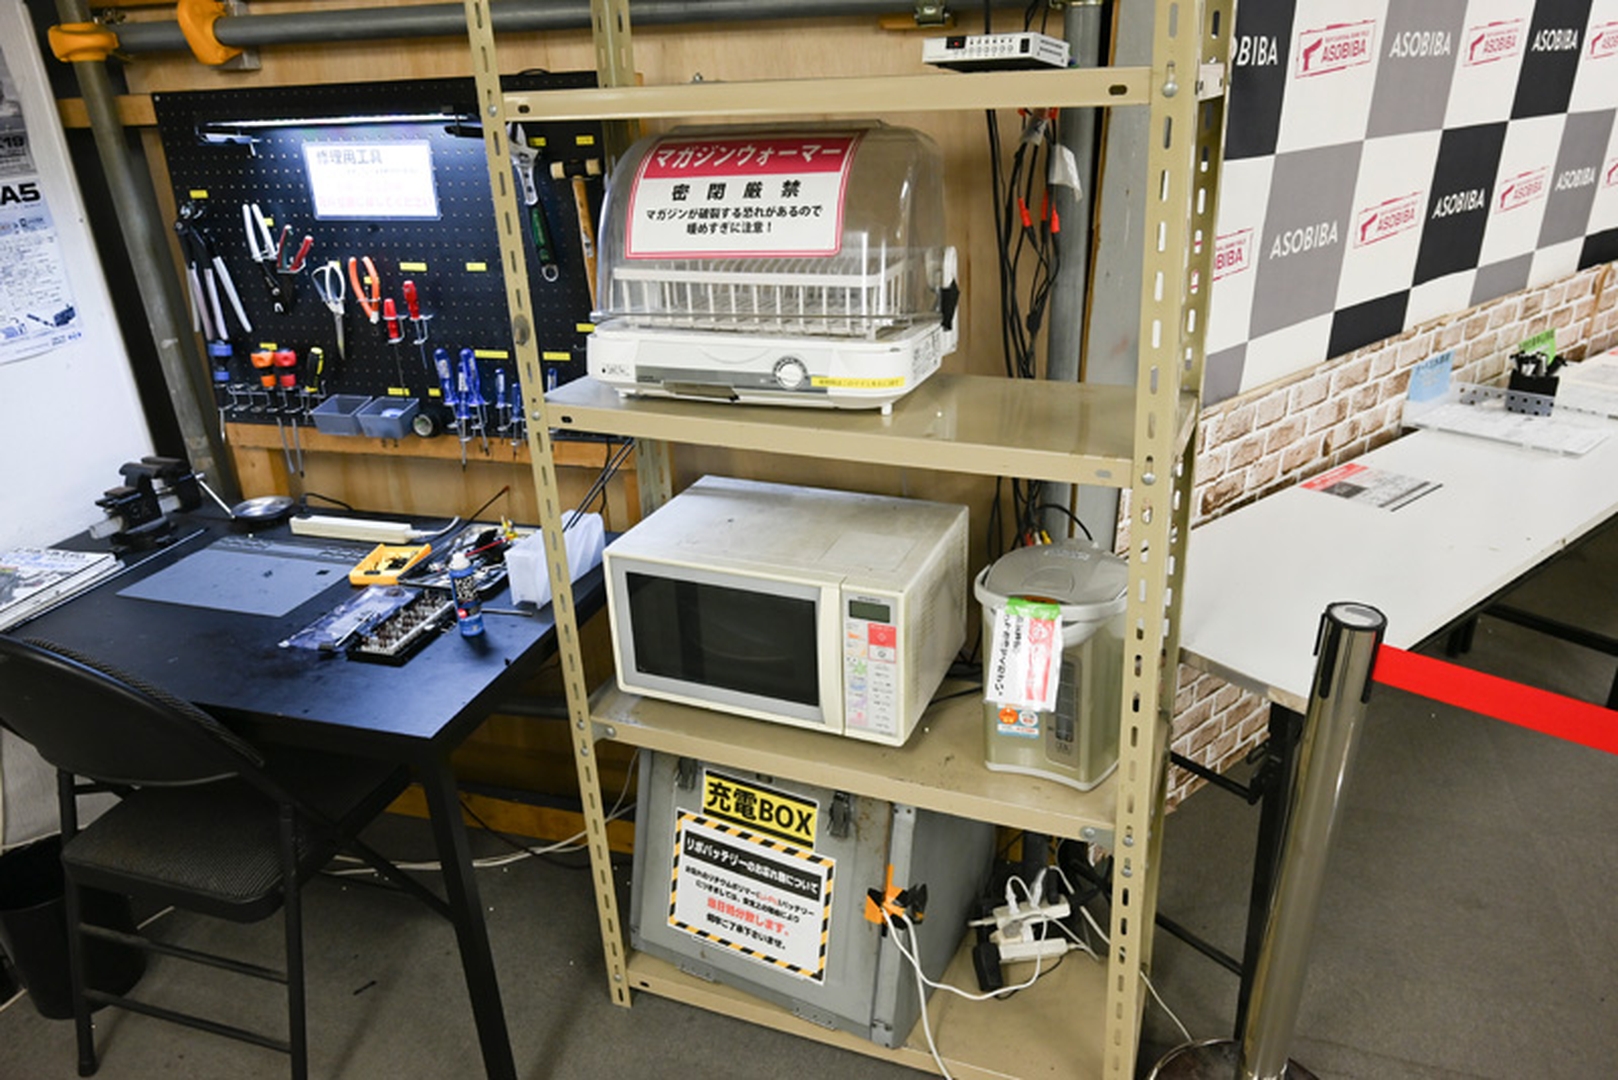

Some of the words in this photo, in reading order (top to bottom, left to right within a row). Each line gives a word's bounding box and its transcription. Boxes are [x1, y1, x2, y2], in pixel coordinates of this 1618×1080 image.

[1321, 38, 1367, 63] ASOBIBA
[1388, 31, 1452, 59] ASOBIBA
[1483, 34, 1517, 54] ASOBIBA
[1530, 28, 1579, 52] ASOBIBA
[316, 149, 383, 165] 修理用工具
[657, 144, 842, 168] マガジンウォーマー
[1555, 166, 1597, 192] ASOBIBA
[646, 204, 823, 221] マガジンが破裂する恐れがあるので
[1432, 187, 1486, 219] ASOBIBA
[1377, 207, 1415, 231] ASOBIBA
[1269, 220, 1338, 260] ASOBIBA
[707, 781, 813, 836] 充電BOX
